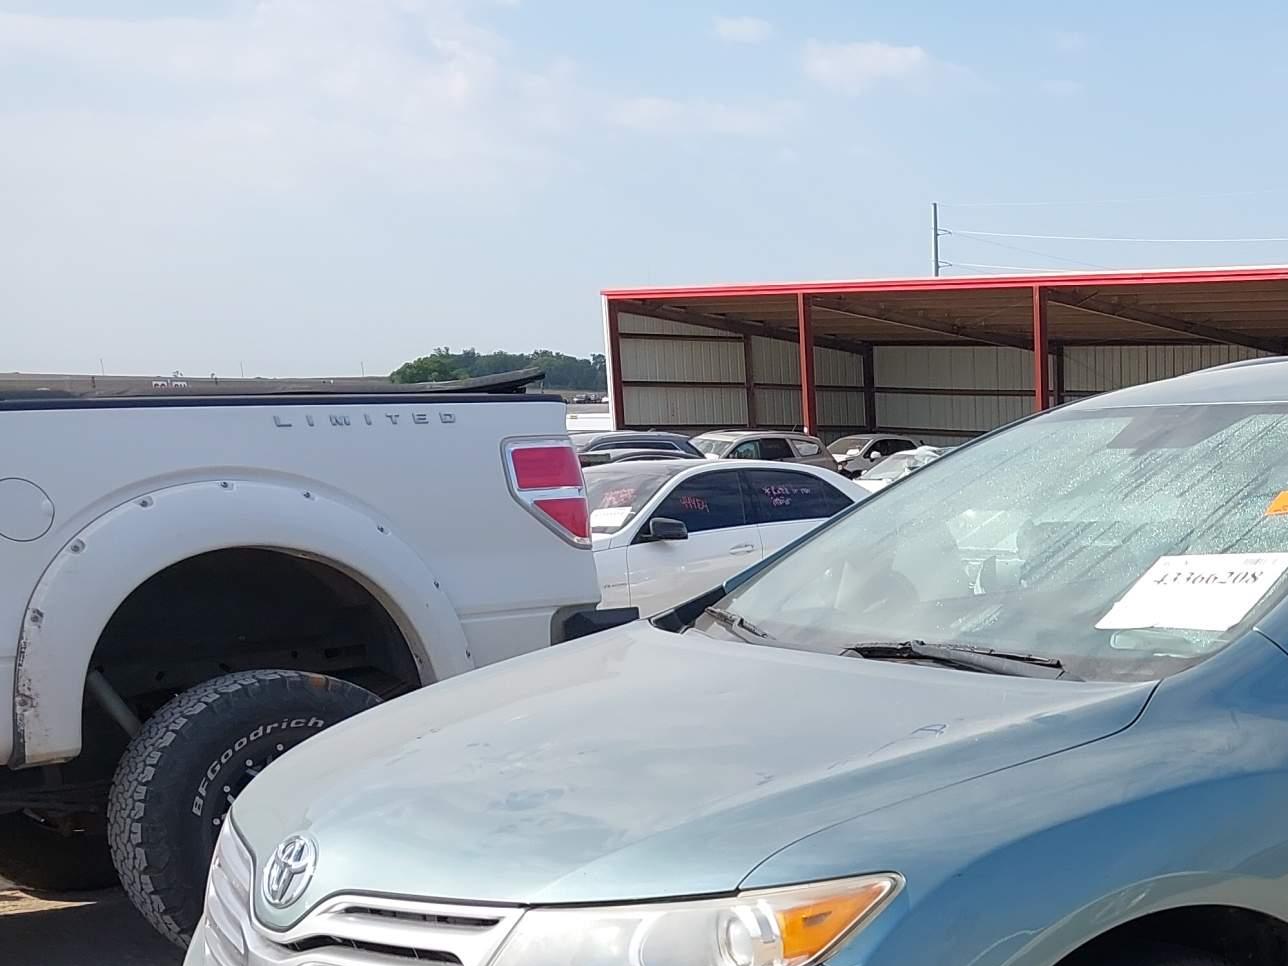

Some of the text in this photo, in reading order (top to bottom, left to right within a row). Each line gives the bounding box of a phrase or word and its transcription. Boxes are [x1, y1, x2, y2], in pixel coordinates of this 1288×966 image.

[273, 412, 456, 428] LIMITED
[1153, 570, 1264, 585] 43366208
[192, 717, 325, 817] BFGoodrich
